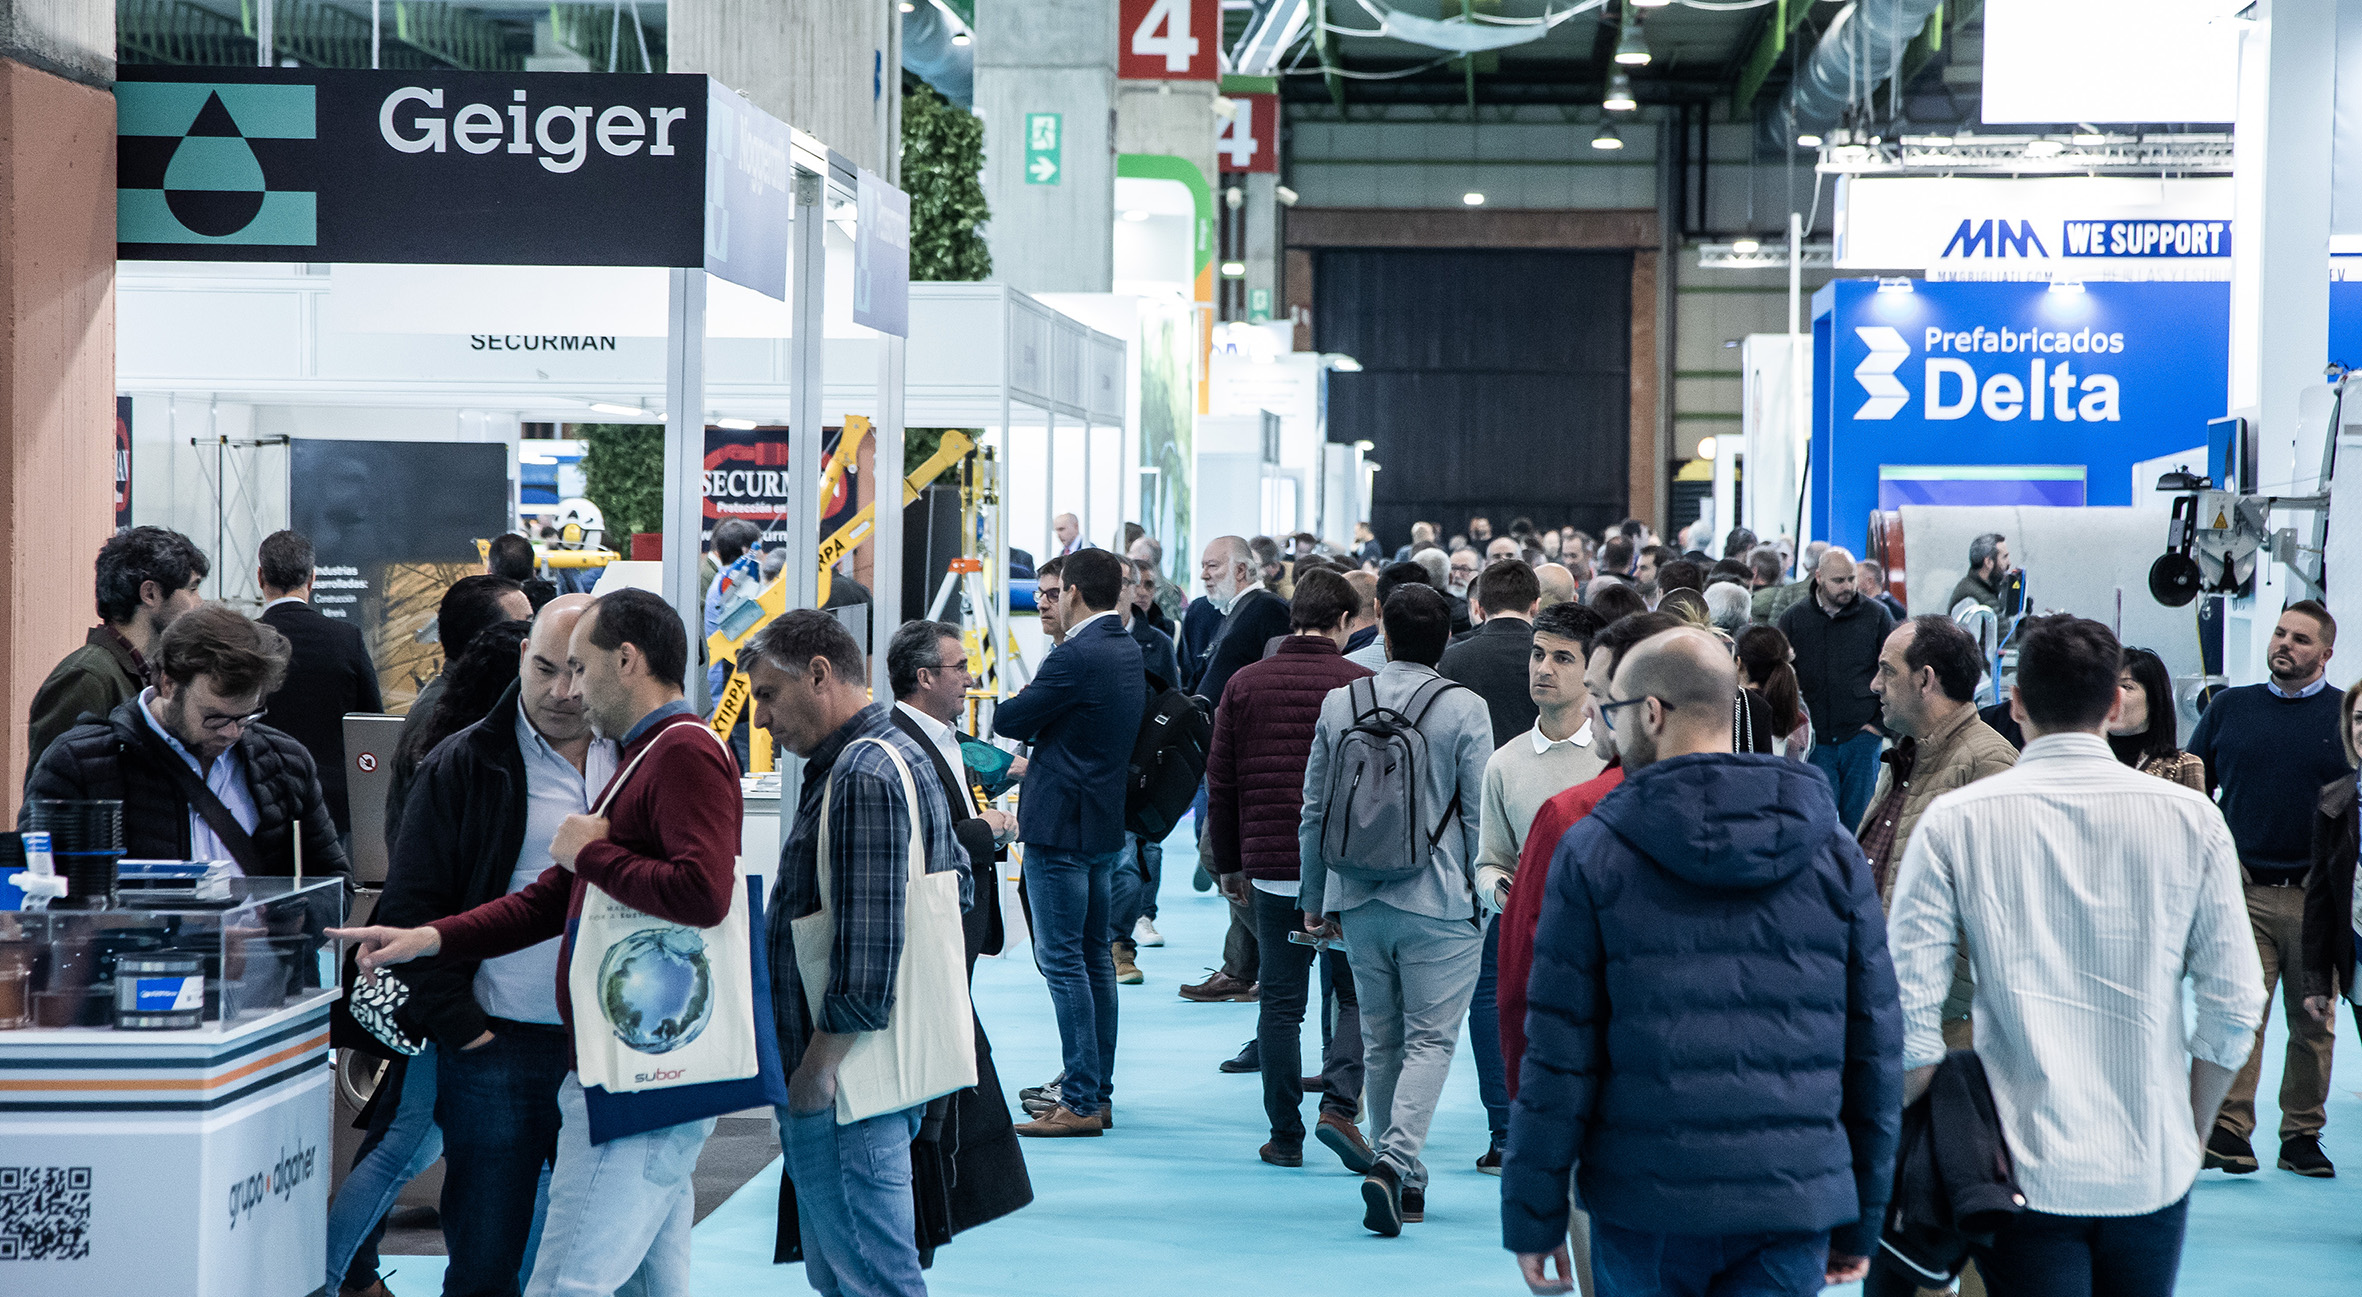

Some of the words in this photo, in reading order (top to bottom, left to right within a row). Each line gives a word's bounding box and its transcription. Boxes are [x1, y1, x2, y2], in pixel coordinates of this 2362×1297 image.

[1131, 0, 1199, 72] 4
[379, 86, 686, 174] Geiger
[1216, 97, 1258, 167] 4
[2066, 223, 2104, 255] WE
[2110, 222, 2224, 255] SUPPORT
[470, 334, 616, 351] SECURMAN
[1925, 326, 2125, 354] Prefabricados
[1925, 358, 2121, 422] Delta
[228, 1171, 264, 1231] grupo
